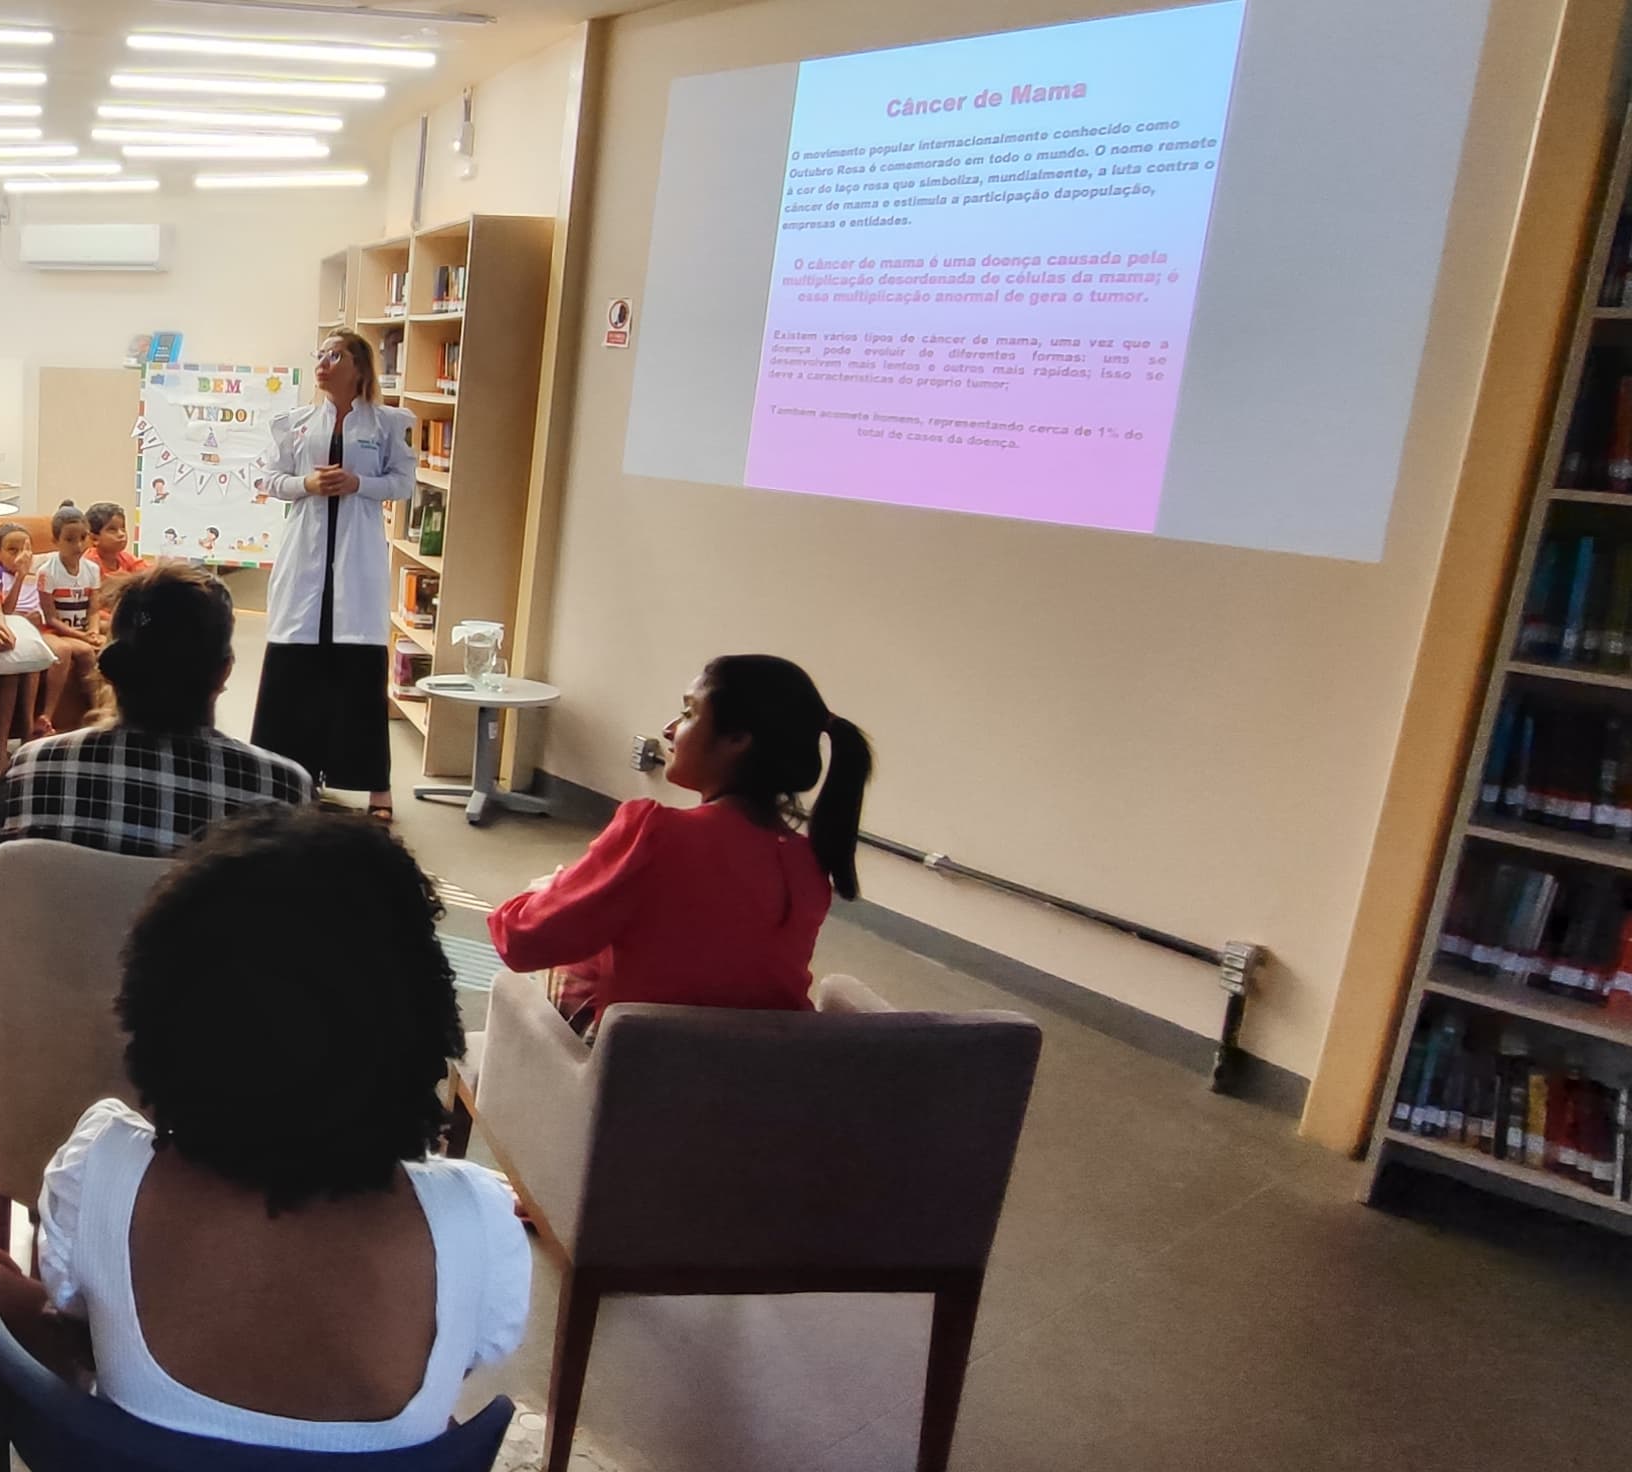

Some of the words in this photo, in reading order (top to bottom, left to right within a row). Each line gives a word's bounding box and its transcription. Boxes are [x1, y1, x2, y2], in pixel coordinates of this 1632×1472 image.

[886, 92, 967, 118] Câncer
[974, 89, 1003, 109] de
[1010, 81, 1088, 106] Mama
[792, 151, 800, 161] O
[803, 146, 865, 160] movimento
[869, 142, 915, 157] popular
[918, 131, 1048, 151] internacionalmente
[1053, 123, 1131, 139] conhecido
[1136, 119, 1180, 132] como
[789, 165, 833, 178] Outubro
[837, 164, 865, 175] Rosa
[869, 163, 876, 173] é
[880, 154, 961, 172] comemorado
[965, 155, 984, 166] em
[989, 151, 1019, 165] todo
[1024, 152, 1032, 162] o
[1036, 146, 1089, 161] mundo.
[1095, 144, 1106, 156] O
[1110, 143, 1153, 155] nome
[1158, 137, 1217, 152] remete
[796, 185, 815, 195] cor
[818, 183, 832, 194] do
[835, 181, 860, 194] laço
[863, 181, 889, 191] rosa
[893, 180, 915, 192] que
[919, 173, 983, 188] simboliza,
[987, 168, 1092, 184] mundialmente,
[1098, 167, 1106, 176] a
[1111, 162, 1142, 175] luta
[1146, 159, 1199, 173] contra
[1204, 160, 1215, 170] o
[784, 201, 823, 213] câncer
[826, 200, 839, 210] de
[843, 199, 879, 209] mama
[882, 199, 890, 208] e
[893, 194, 947, 207] estimula
[951, 195, 959, 204] a
[963, 186, 1049, 206] participação
[782, 218, 836, 231] empresas
[839, 219, 847, 228] e
[850, 215, 912, 227] entidades.
[794, 258, 804, 270] O
[808, 257, 855, 270] câncer
[858, 257, 876, 269] de
[880, 258, 925, 269] mama
[930, 254, 938, 268] é
[943, 257, 976, 268] uma
[981, 253, 1042, 269] doença
[1047, 251, 1121, 266] causada
[1127, 250, 1168, 267] pela
[782, 273, 874, 288] multiplicação
[878, 272, 975, 285] desordenada
[981, 272, 1000, 285] de
[1005, 270, 1066, 285] células
[1071, 271, 1093, 284] da
[1099, 272, 1162, 286] mama;
[1167, 268, 1179, 283] é
[833, 289, 930, 304] multiplicação
[935, 289, 999, 303] anormal
[1004, 289, 1024, 303] de
[1029, 291, 1067, 306] gera
[1072, 292, 1083, 302] o
[1090, 290, 1149, 303] tumor.
[773, 330, 817, 341] Existem
[864, 333, 893, 345] tipos
[900, 334, 915, 344] de
[921, 333, 966, 345] câncer
[972, 335, 989, 345] de
[1050, 337, 1081, 347] uma
[1089, 339, 1115, 348] vez
[1122, 339, 1151, 351] que
[1159, 340, 1169, 349] a
[771, 344, 811, 355] doença
[823, 345, 852, 356] pode
[864, 346, 906, 357] evoluir
[919, 347, 934, 358] de
[948, 348, 1016, 360] diferentes
[1103, 354, 1130, 364] uns
[1148, 356, 1167, 366] se
[769, 356, 842, 368] desenvolvem
[848, 358, 876, 369] mais
[883, 359, 921, 371] lentos
[943, 362, 984, 374] outros
[992, 364, 1025, 376] mais
[1145, 370, 1165, 381] se
[197, 376, 242, 394] BEM
[898, 374, 912, 385] do
[857, 426, 885, 438] total
[888, 429, 903, 440] de
[906, 431, 943, 443] casos
[947, 433, 963, 445] da
[928, 416, 1024, 433] representando
[1028, 424, 1069, 435] cerca
[1074, 425, 1092, 437] de
[1124, 428, 1144, 441] do
